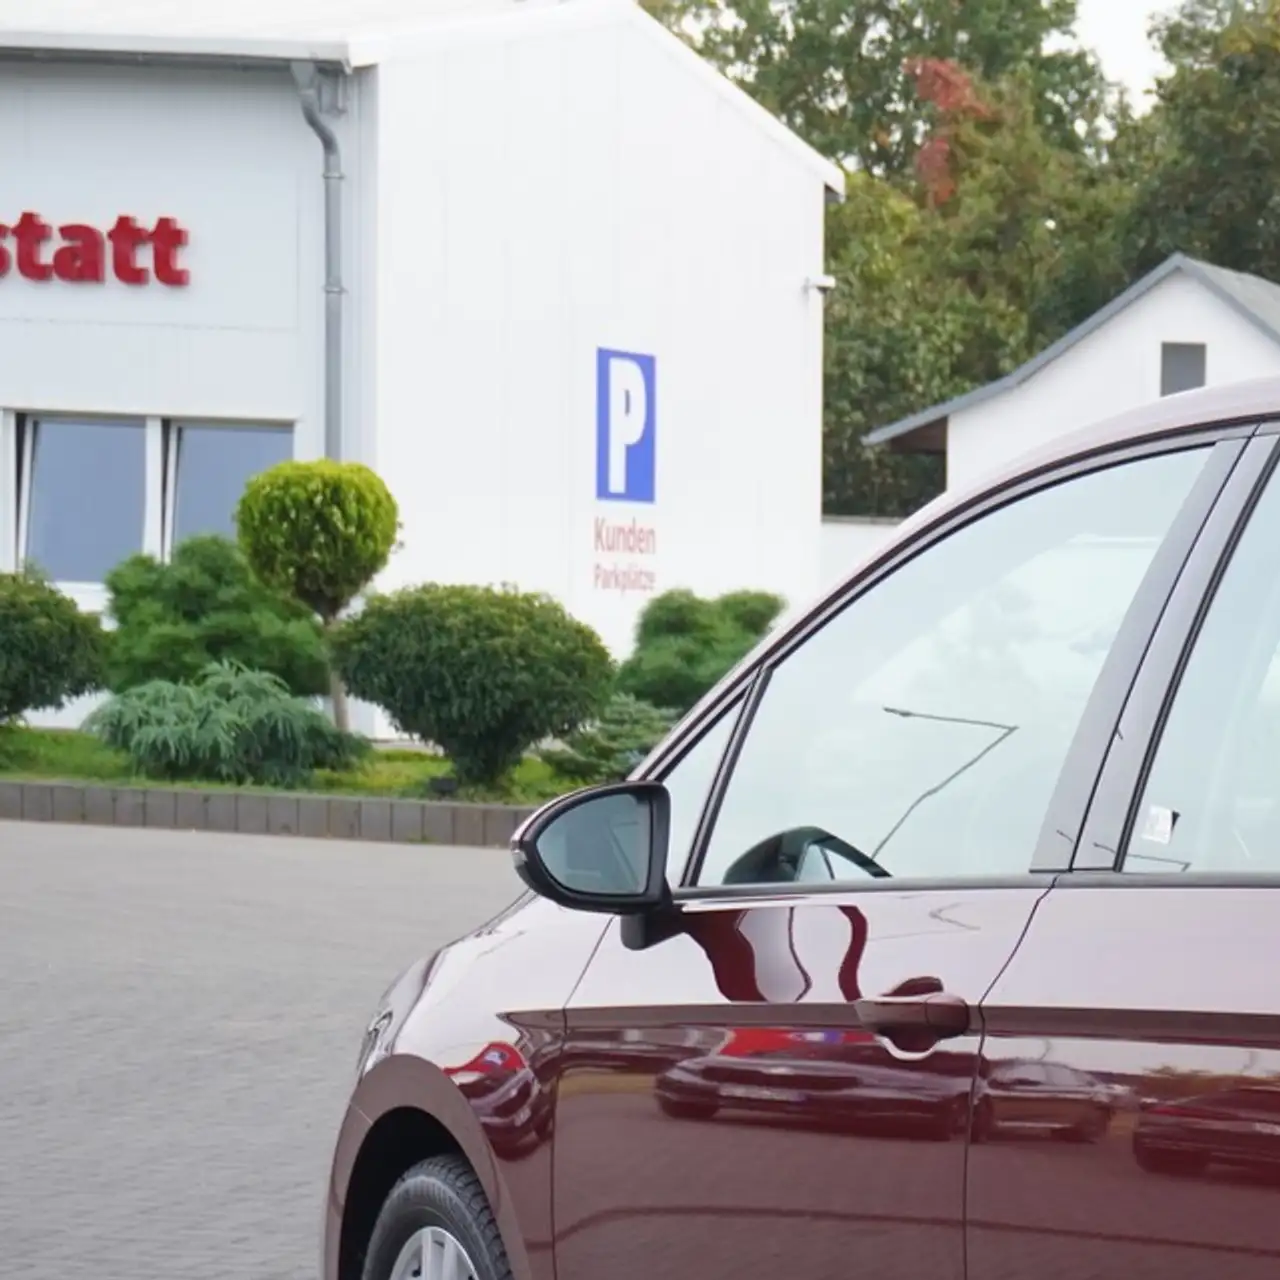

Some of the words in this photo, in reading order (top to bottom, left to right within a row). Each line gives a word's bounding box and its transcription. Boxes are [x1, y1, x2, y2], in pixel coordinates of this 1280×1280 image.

[0, 211, 190, 286] tatt
[608, 357, 648, 494] P
[594, 516, 656, 554] Kunden
